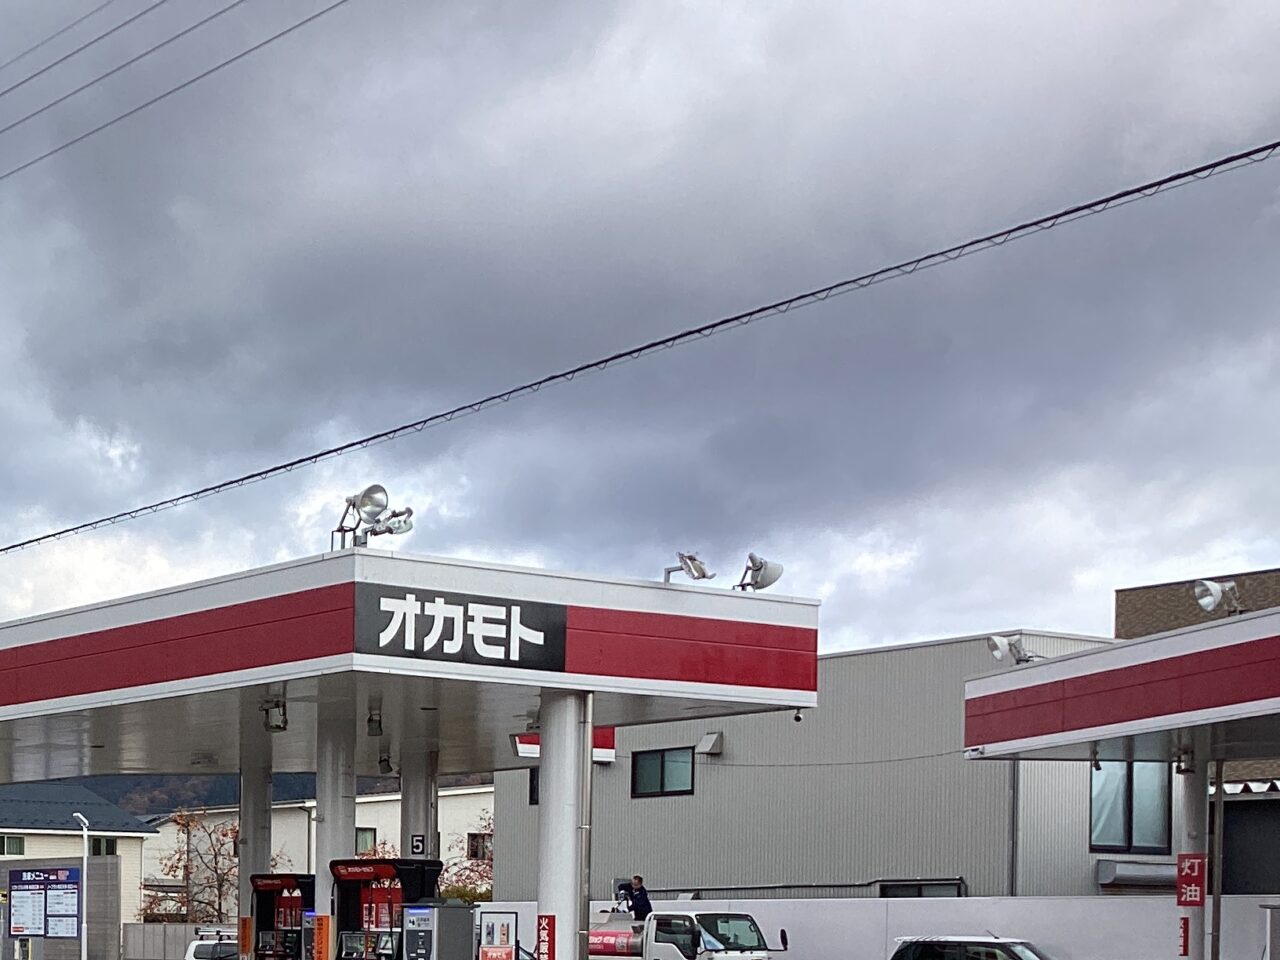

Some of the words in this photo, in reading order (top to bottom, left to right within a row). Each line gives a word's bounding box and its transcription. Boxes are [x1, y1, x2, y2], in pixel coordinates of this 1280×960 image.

[379, 593, 545, 661] オカモト
[412, 836, 423, 853] 5
[1181, 859, 1201, 901] 灯油
